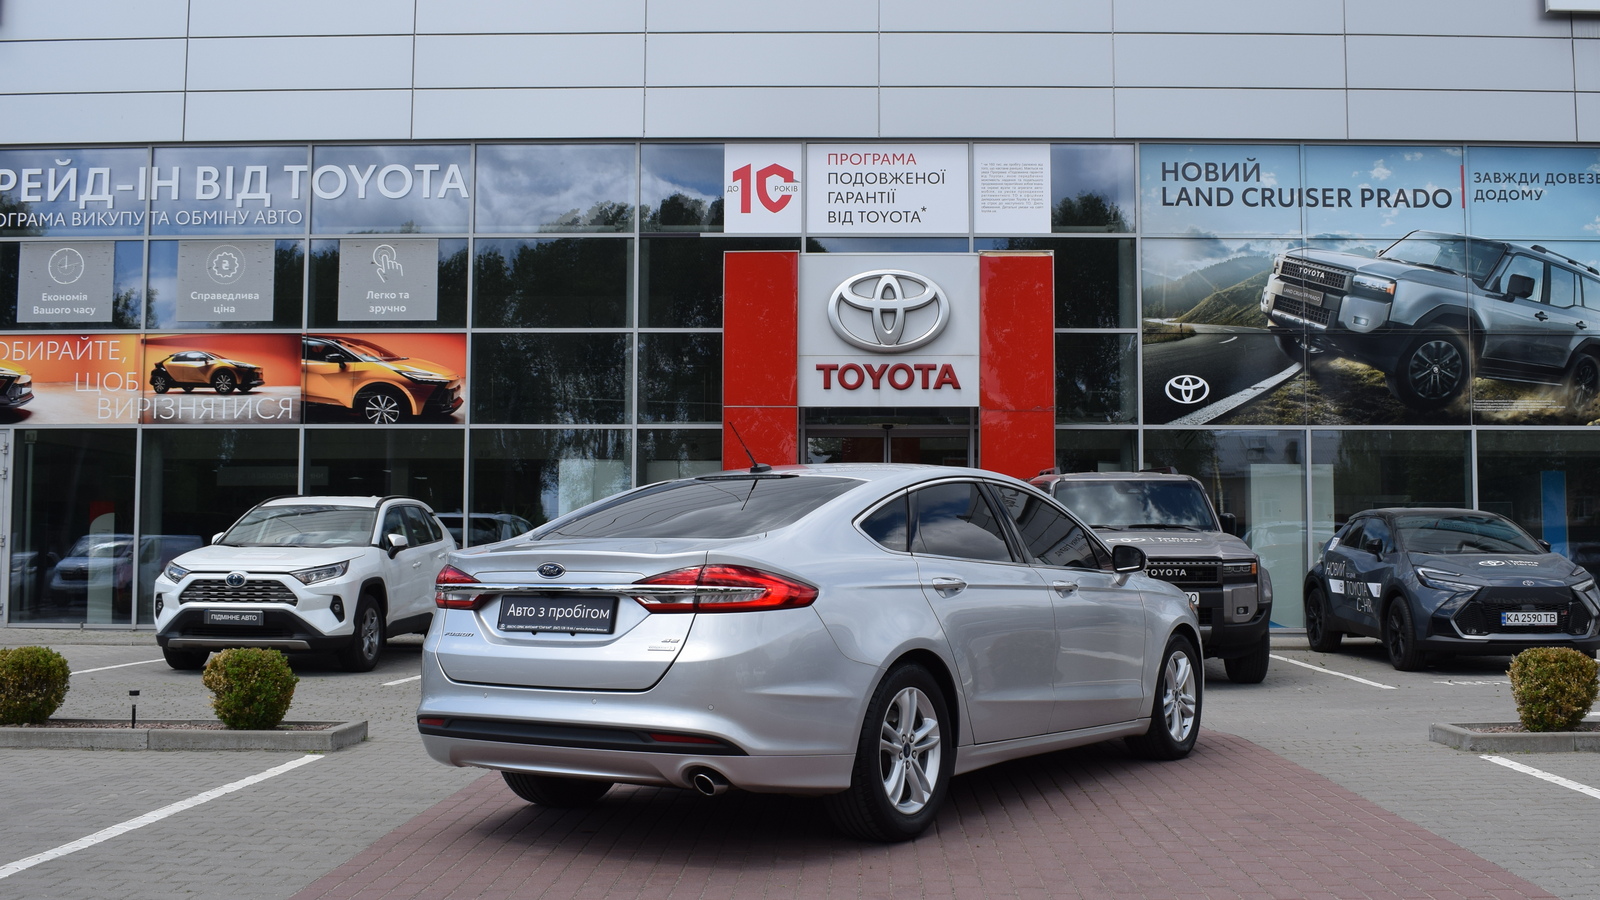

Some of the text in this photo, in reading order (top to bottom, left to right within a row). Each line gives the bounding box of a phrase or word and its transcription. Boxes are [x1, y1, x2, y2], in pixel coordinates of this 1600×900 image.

[827, 153, 917, 166] ПРОГРАМА
[827, 169, 946, 187] ПОДОВЖЕНОЇ
[1161, 157, 1261, 183] НОВИЙ
[196, 165, 272, 208] ВІД
[284, 163, 470, 200] TOYOTA
[1473, 172, 1540, 186] ЗАВЖДИ
[727, 185, 739, 193] ДО
[732, 163, 794, 214] 10
[827, 188, 897, 204] ГАРАНТІЇ
[1474, 189, 1543, 203] ДОДОМУ
[1161, 186, 1453, 209] LAND CRUISER PRADO
[72, 211, 145, 226] ВИКУПУ
[150, 211, 170, 225] ТА
[175, 210, 250, 226] ОБМІНУ
[254, 209, 302, 225] АВТО
[827, 210, 854, 226] ВІД
[1299, 267, 1325, 279] TOYOTA
[41, 292, 88, 302] Економія
[190, 291, 260, 301] Справедлива
[366, 290, 410, 300] Легко та
[33, 305, 96, 316] Вашого часу
[213, 305, 236, 314] ціна
[368, 304, 407, 314] зручно
[75, 372, 139, 396] ЩОБ
[815, 362, 962, 391] TOYOTA
[98, 397, 293, 419] ВИРІЗНЯТИСЯ
[1144, 568, 1187, 577] TOYOTA
[1324, 560, 1346, 577] НОВИЙ
[1346, 580, 1369, 597] TOYOTA
[507, 603, 610, 621] Авто з пробігом
[1356, 597, 1373, 613] C-HR
[210, 613, 240, 621] ПІДМІННЕ
[1506, 613, 1520, 623] KA
[1521, 613, 1543, 623] 2590
[1544, 613, 1556, 623] TB
